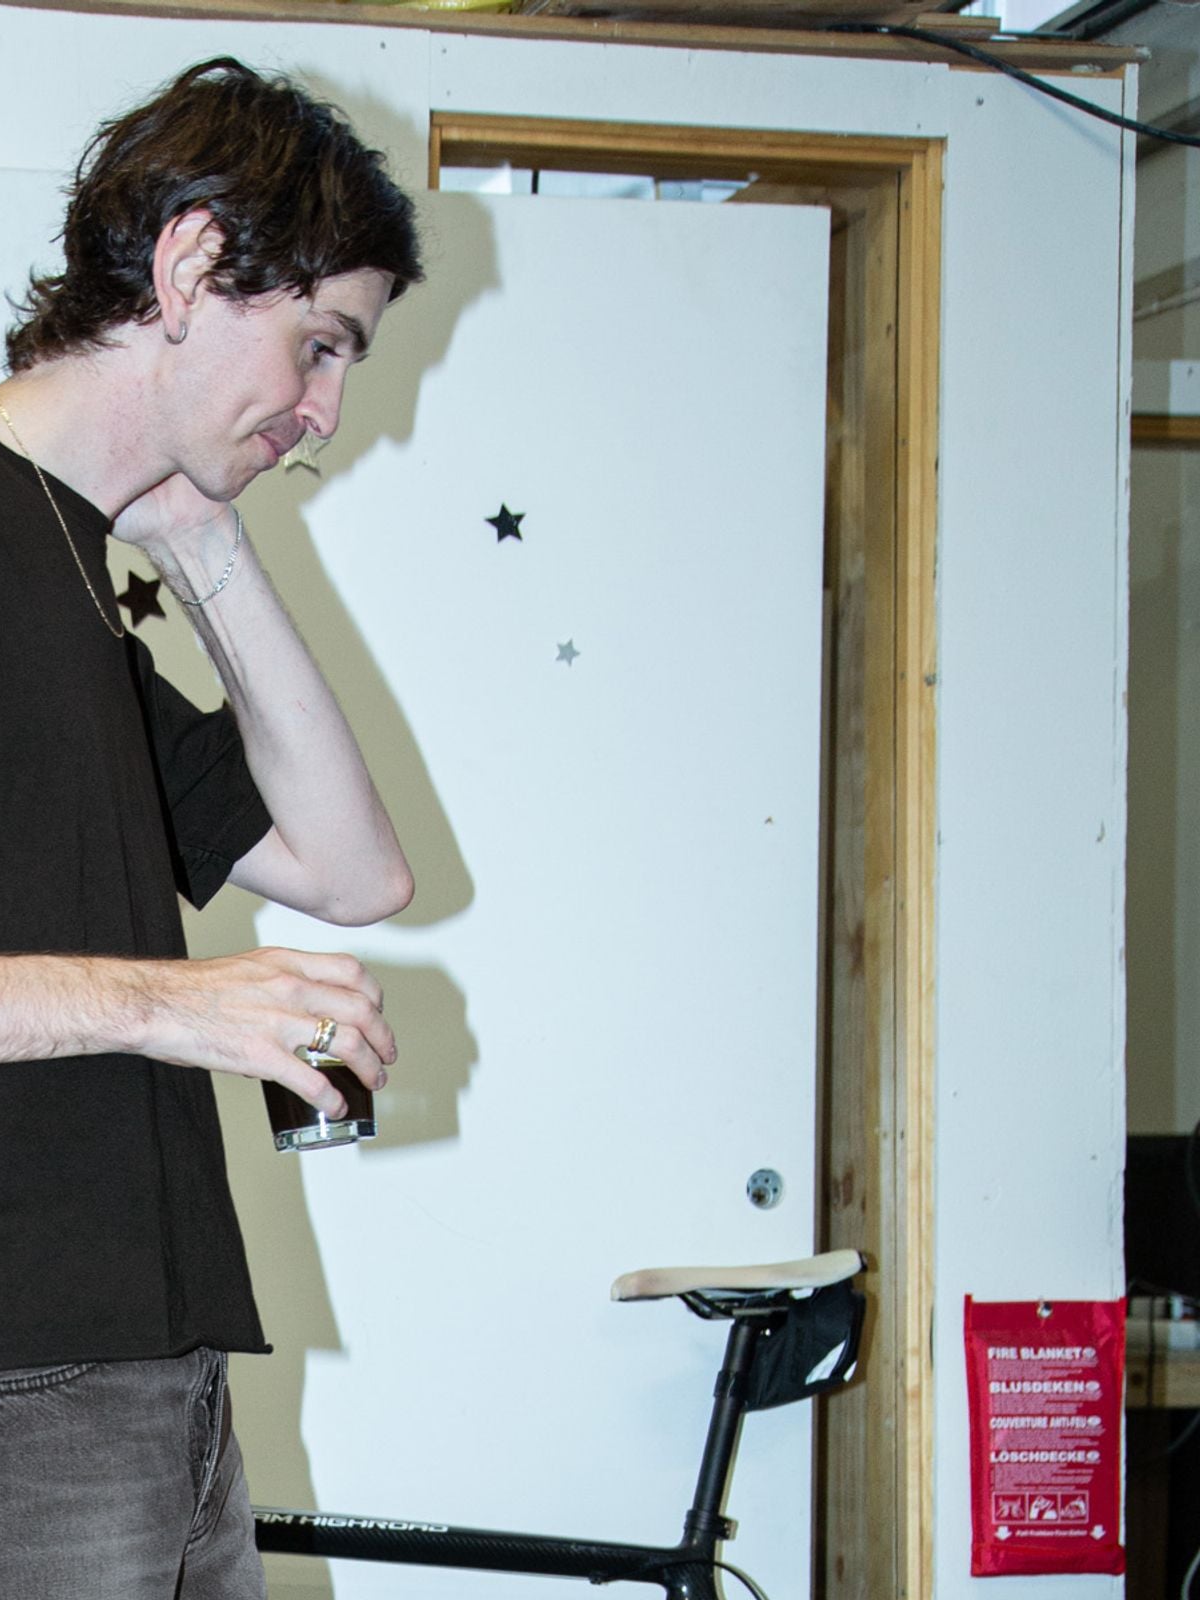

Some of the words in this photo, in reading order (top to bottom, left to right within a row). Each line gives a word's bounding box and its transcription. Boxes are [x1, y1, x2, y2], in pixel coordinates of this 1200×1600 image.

[988, 1347, 1018, 1360] FIRE
[1020, 1347, 1081, 1360] BLANKET
[990, 1381, 1085, 1393] BLUSDEKEN
[300, 1516, 449, 1533] HIGHROAD
